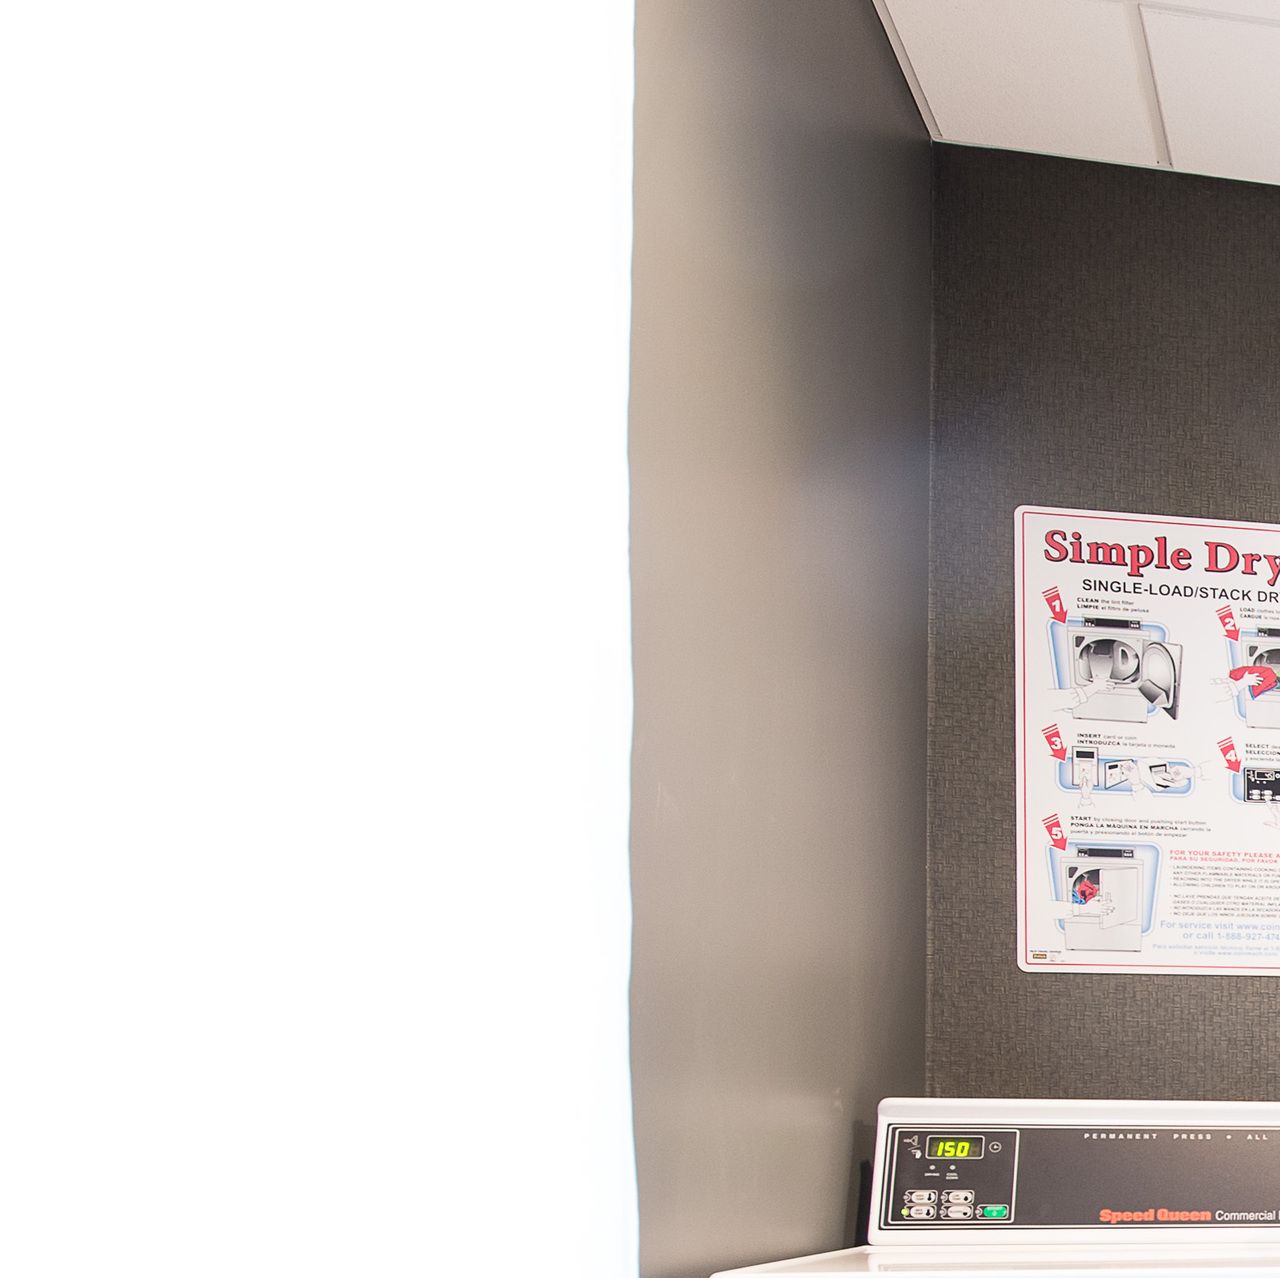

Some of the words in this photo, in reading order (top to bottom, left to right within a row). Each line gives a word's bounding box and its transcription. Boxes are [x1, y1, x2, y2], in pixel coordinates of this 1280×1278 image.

[1044, 530, 1191, 577] Simple
[1082, 579, 1251, 602] SINGLE-LOAD/STACK
[1052, 600, 1061, 612] 1
[1224, 618, 1236, 630] 2
[1050, 737, 1062, 749] 3
[1226, 749, 1238, 761] 4
[1050, 827, 1063, 839] 5
[1160, 920, 1176, 929] For
[1178, 921, 1212, 929] service
[1214, 921, 1234, 930] visit
[1196, 931, 1214, 940] call
[937, 1141, 970, 1157] 150
[1100, 1208, 1155, 1223] Speed
[1157, 1208, 1211, 1221] Queen
[1215, 1210, 1276, 1221] Commercial
